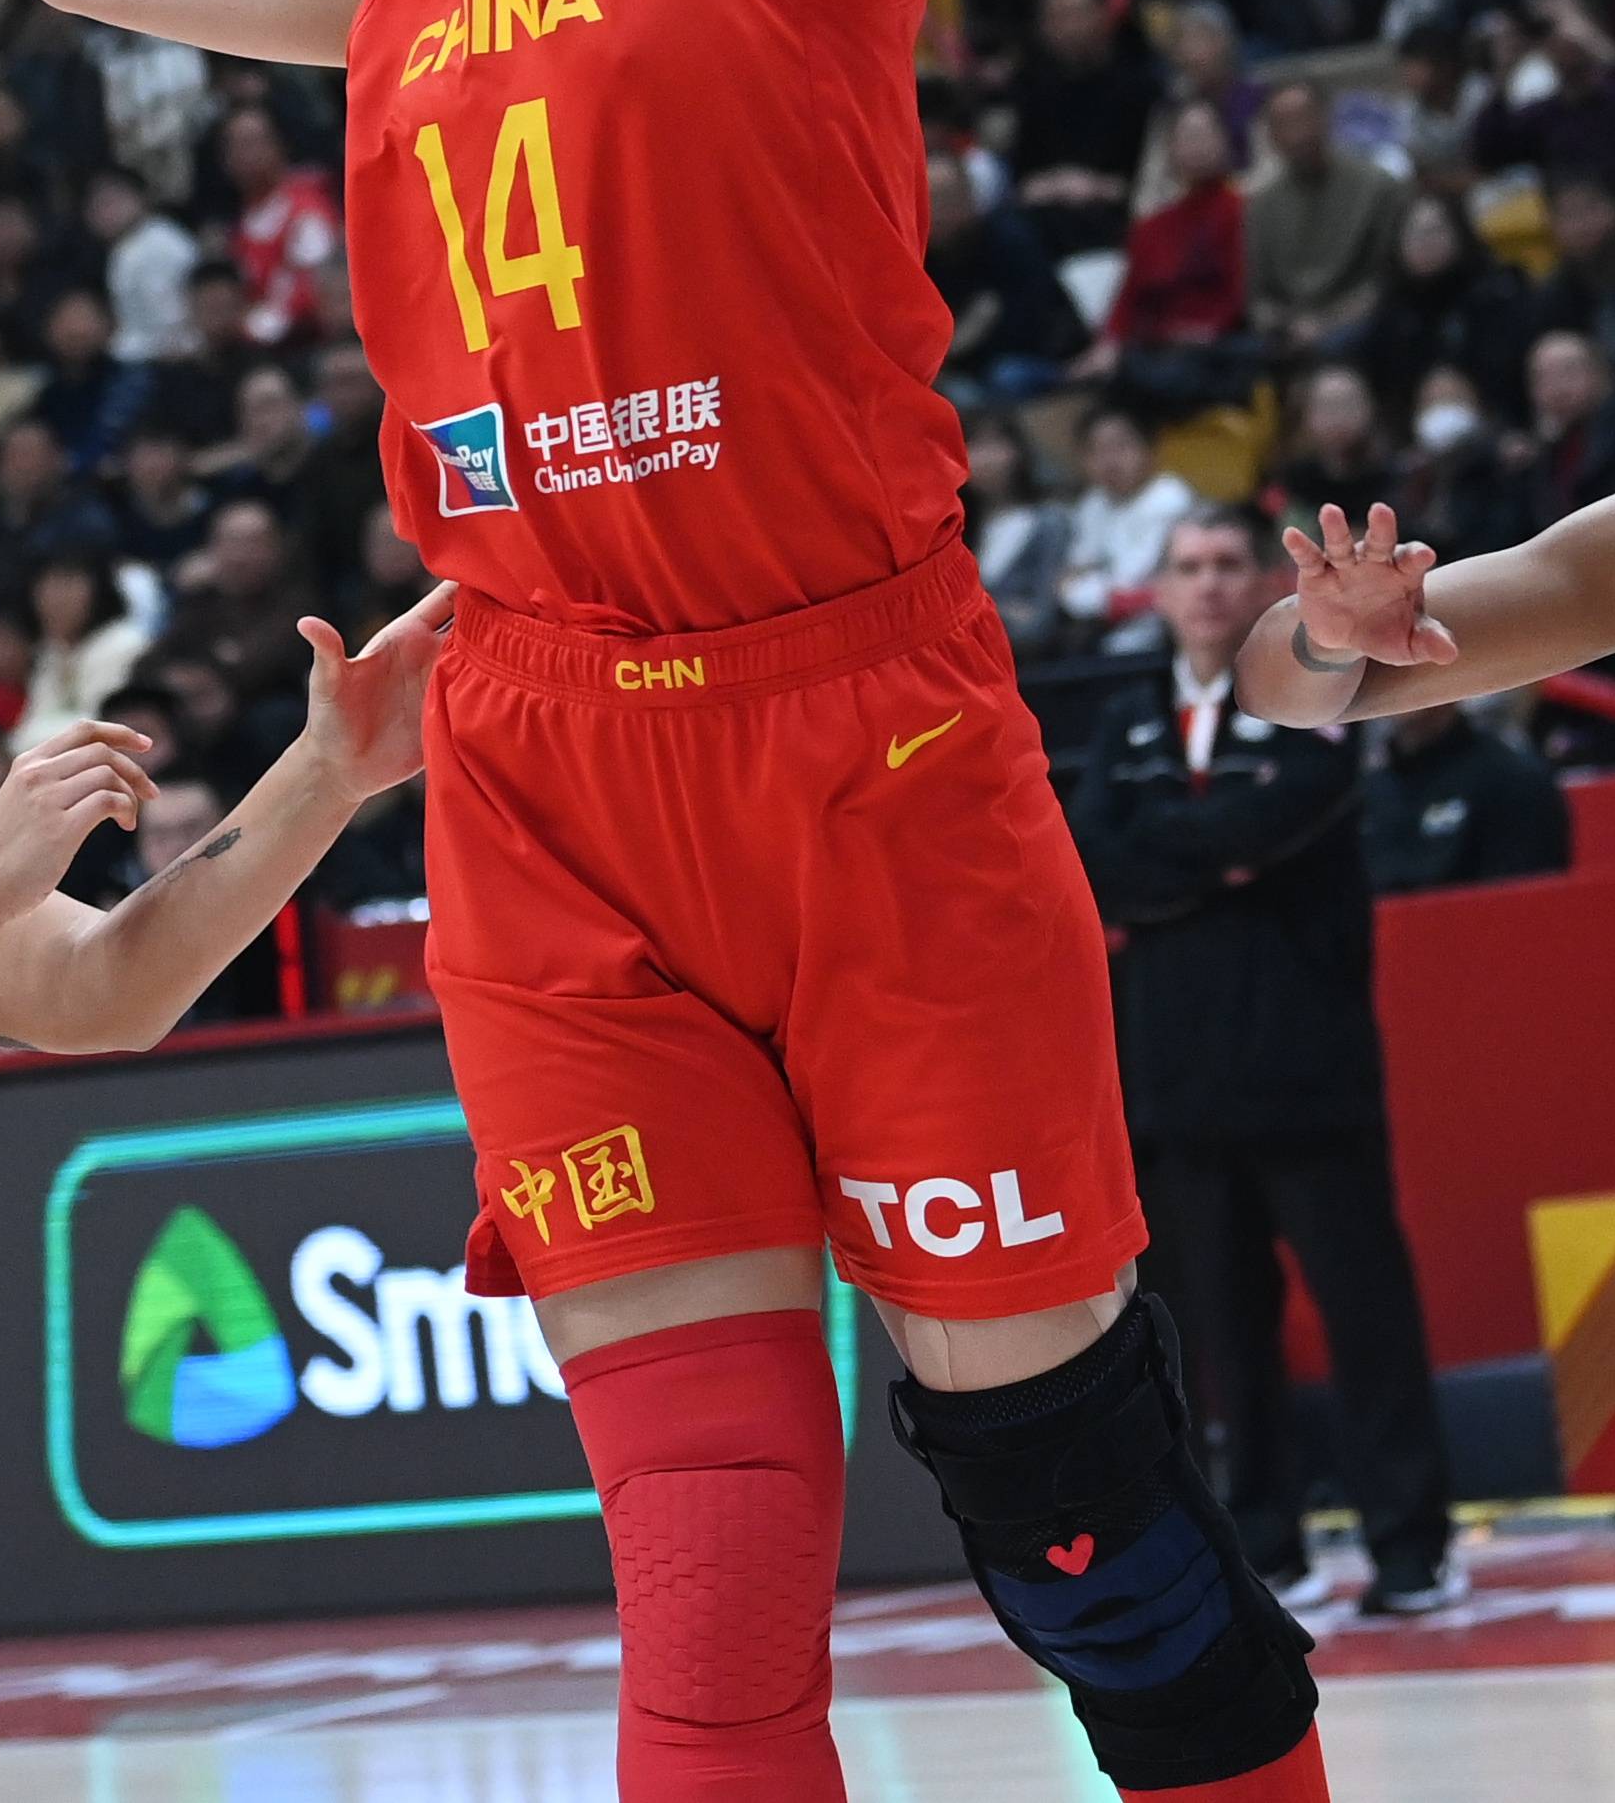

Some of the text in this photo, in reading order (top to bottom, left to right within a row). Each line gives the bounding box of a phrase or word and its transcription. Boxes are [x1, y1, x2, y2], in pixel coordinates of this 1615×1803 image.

[413, 97, 585, 353] 14
[524, 376, 721, 461] 中国银联
[534, 440, 721, 494] China UnionPay
[614, 656, 705, 691] CHN
[500, 1123, 655, 1247] 中国
[838, 1168, 1065, 1259] TCL
